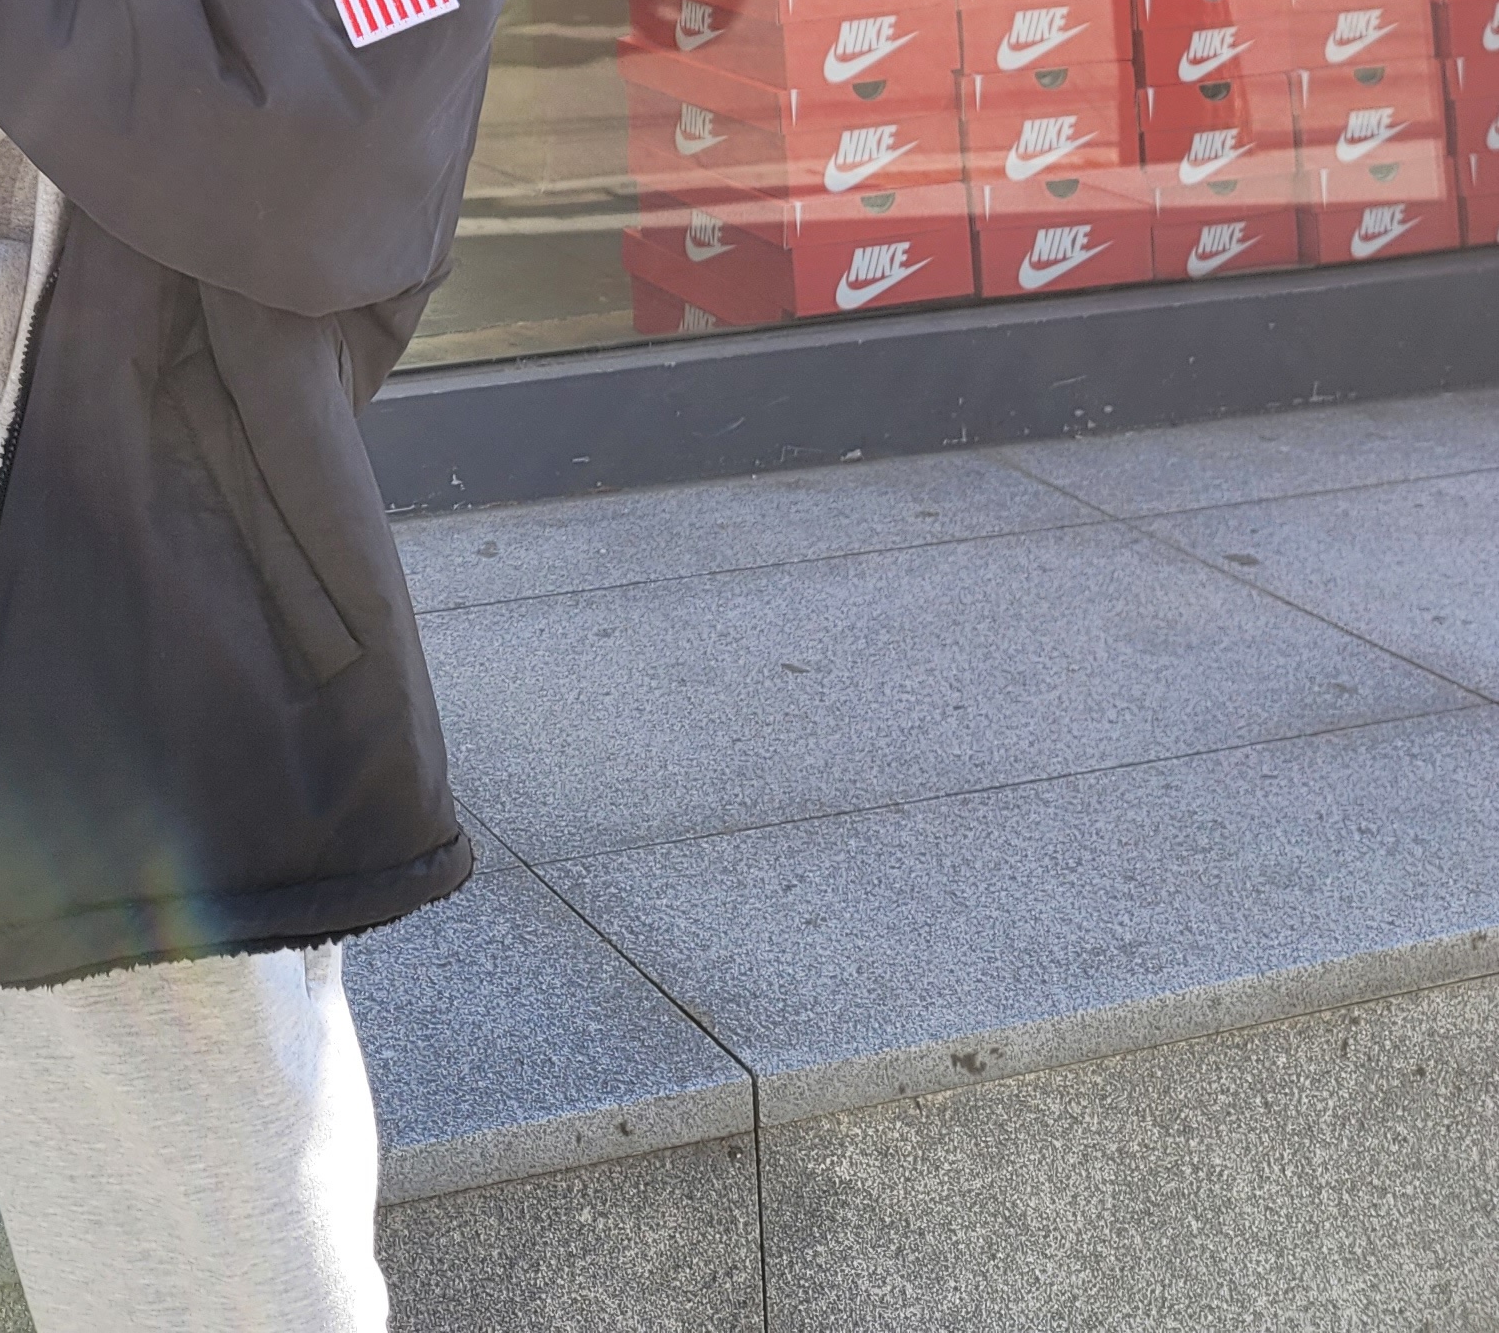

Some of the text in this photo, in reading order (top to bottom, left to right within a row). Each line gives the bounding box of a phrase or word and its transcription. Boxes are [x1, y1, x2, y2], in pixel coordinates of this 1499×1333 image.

[681, 0, 714, 31] NIKE
[1010, 7, 1070, 46] NIKE
[1334, 9, 1384, 42] NIKE
[838, 16, 898, 59] NIKE
[1187, 27, 1236, 58] NIKE
[681, 103, 713, 137] NIKE
[1019, 116, 1078, 156] NIKE
[1345, 107, 1394, 140] NIKE
[838, 125, 898, 167] NIKE
[1188, 129, 1239, 161] NIKE
[691, 211, 722, 246] NIKE
[1195, 222, 1245, 254] NIKE
[1359, 204, 1406, 238] NIKE
[851, 242, 912, 283] NIKE
[1031, 226, 1092, 266] NIKE
